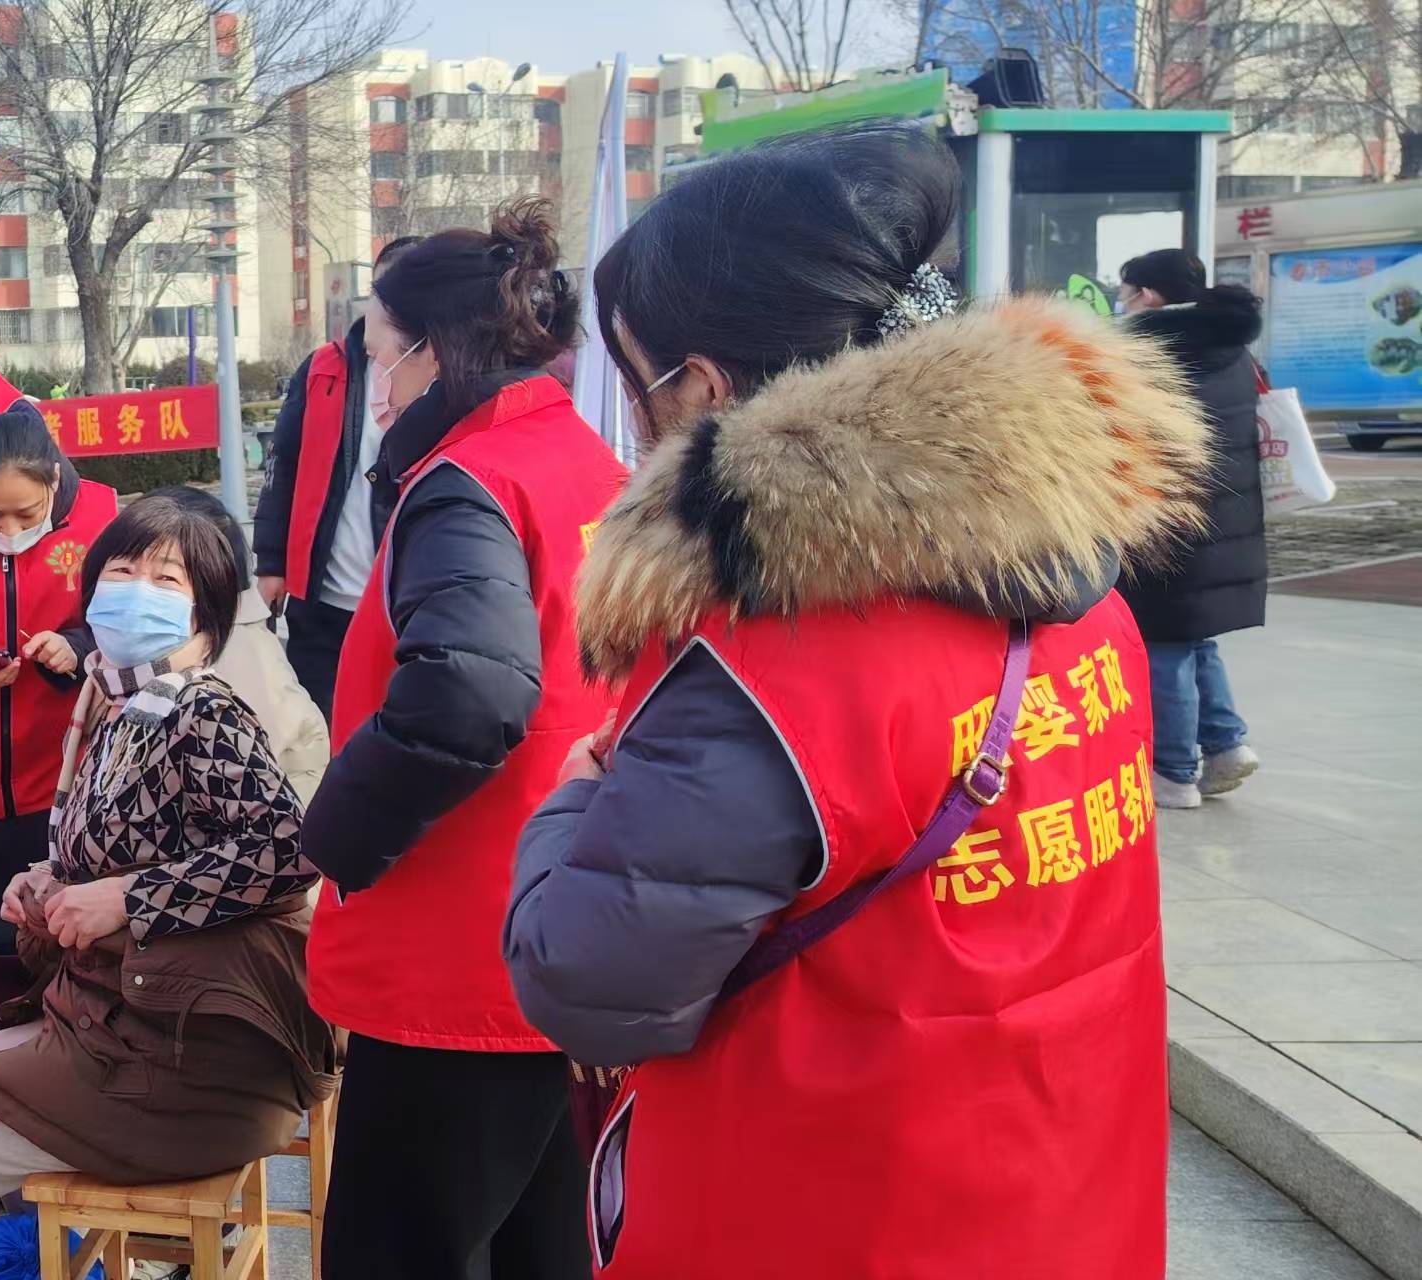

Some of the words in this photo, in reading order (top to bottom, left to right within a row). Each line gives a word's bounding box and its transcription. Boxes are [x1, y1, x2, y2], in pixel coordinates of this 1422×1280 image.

[1237, 206, 1273, 241] 栏
[934, 741, 1155, 904] 志愿服务队
